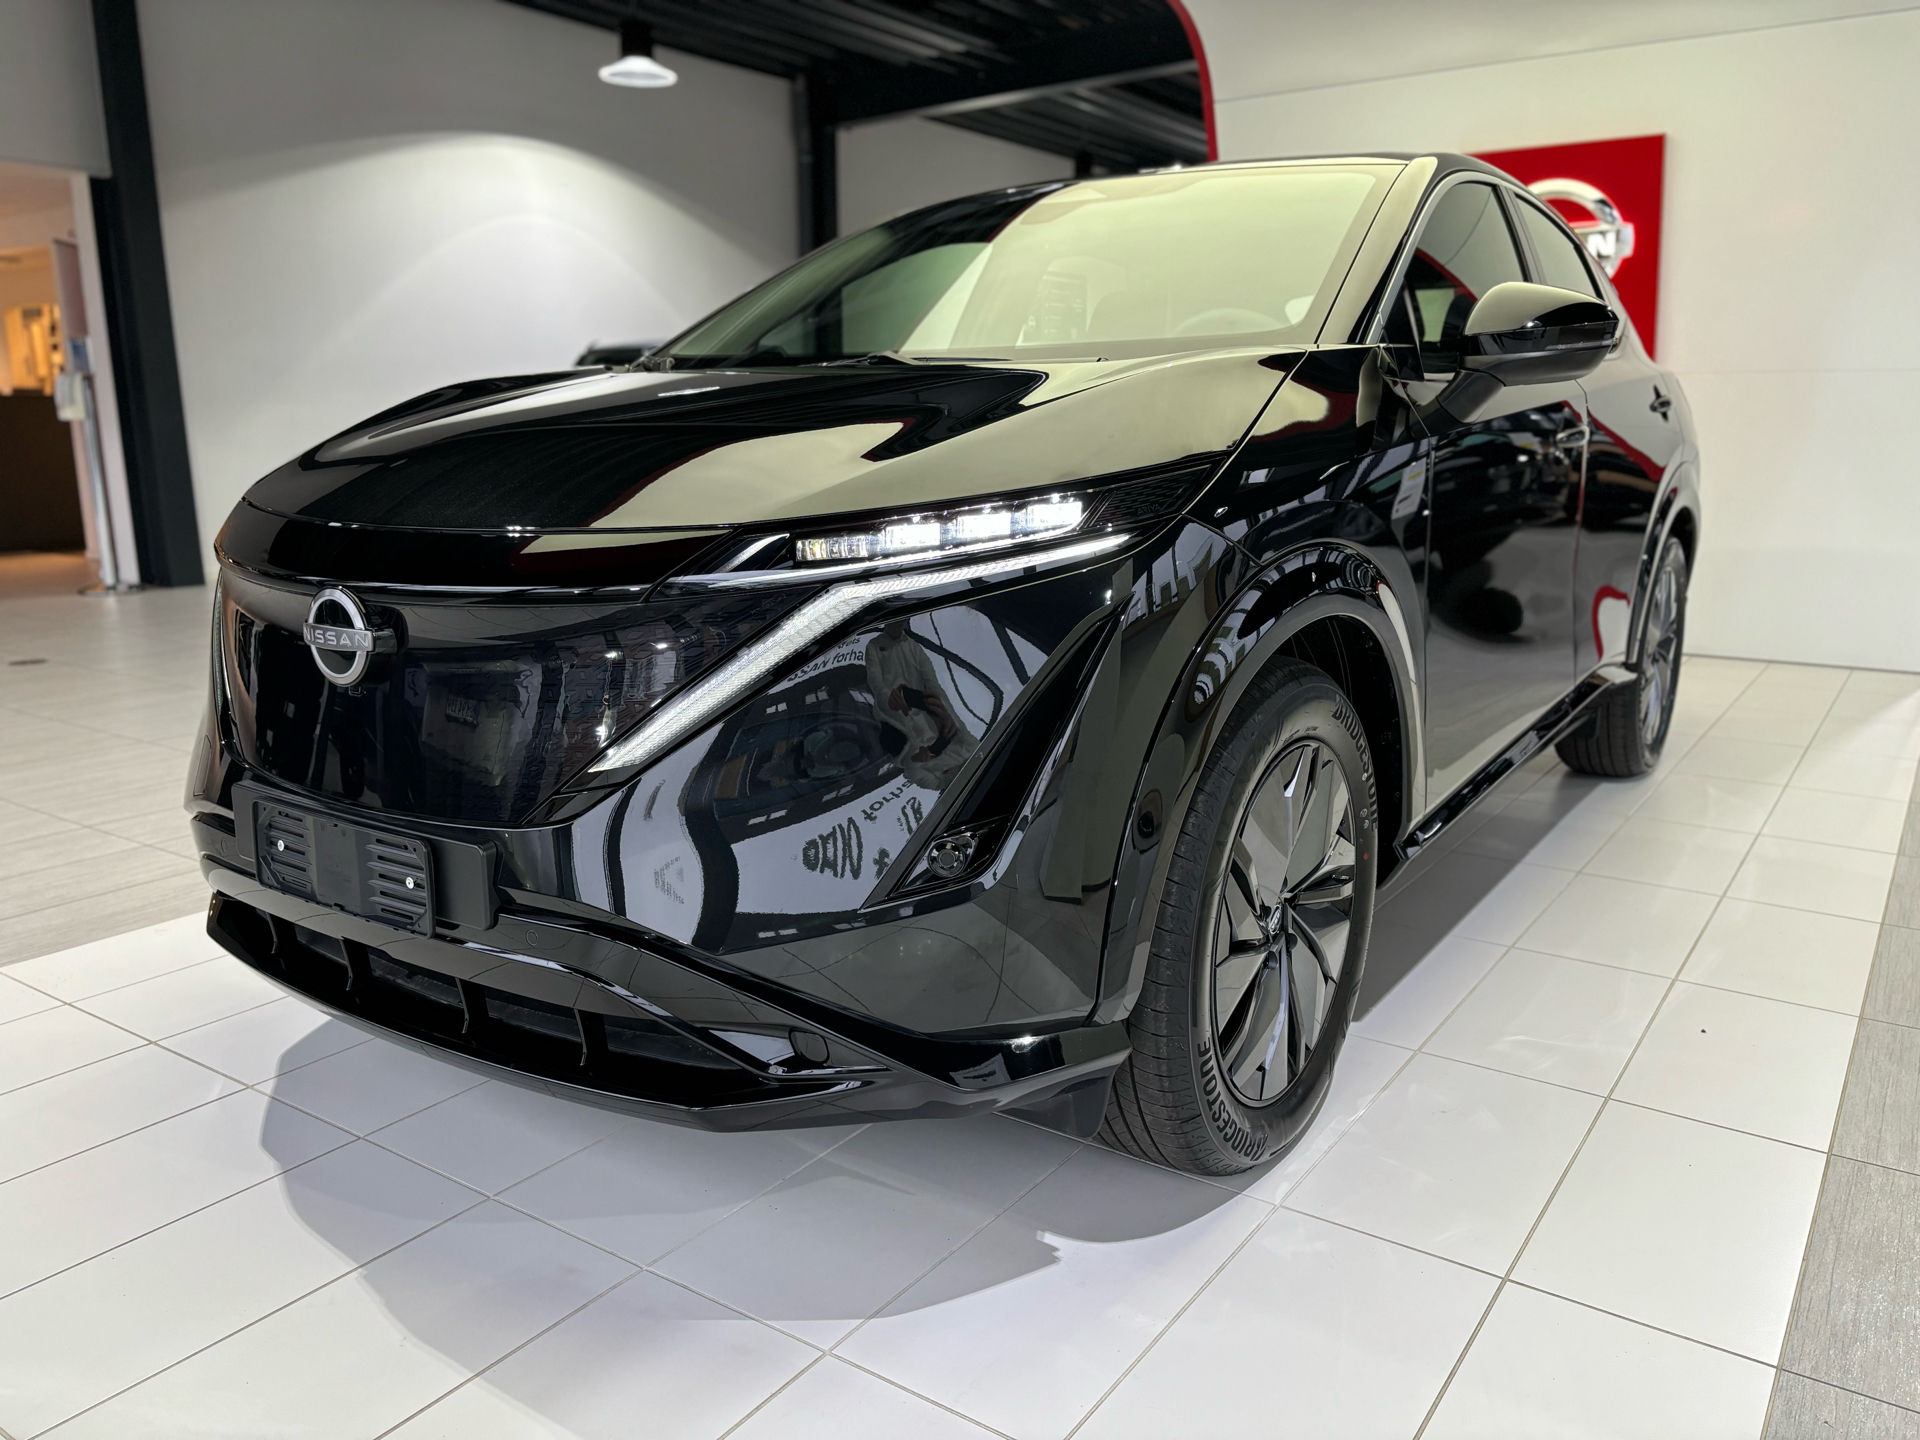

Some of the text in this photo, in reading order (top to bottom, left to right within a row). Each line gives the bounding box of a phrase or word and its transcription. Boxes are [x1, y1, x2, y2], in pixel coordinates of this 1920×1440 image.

[303, 625, 369, 648] NISSAN
[1332, 698, 1378, 832] BRIDGESTONE
[1197, 1037, 1268, 1161] BRIDGESTONE
